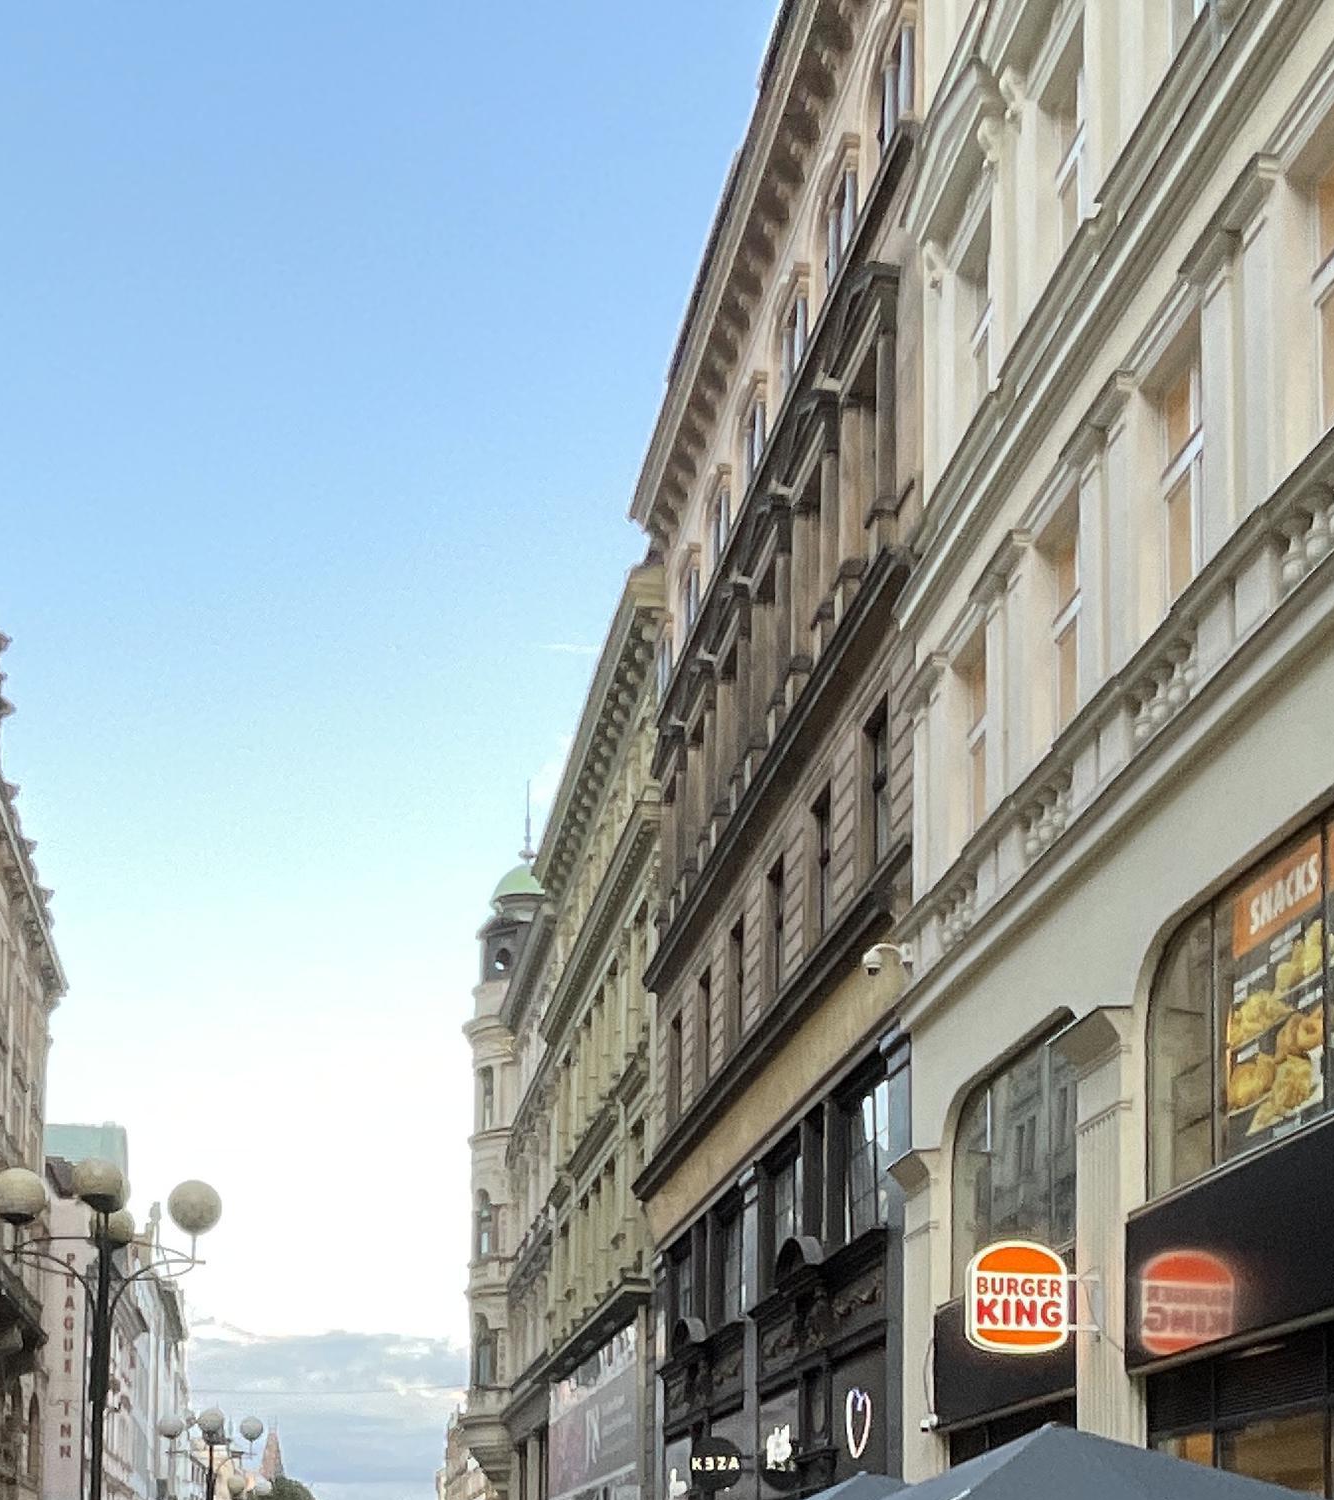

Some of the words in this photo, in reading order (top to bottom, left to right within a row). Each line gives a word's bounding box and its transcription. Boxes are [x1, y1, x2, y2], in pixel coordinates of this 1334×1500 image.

[1249, 853, 1318, 935] SNACKS
[976, 1276, 1063, 1297] BURGER
[976, 1298, 1063, 1327] KING
